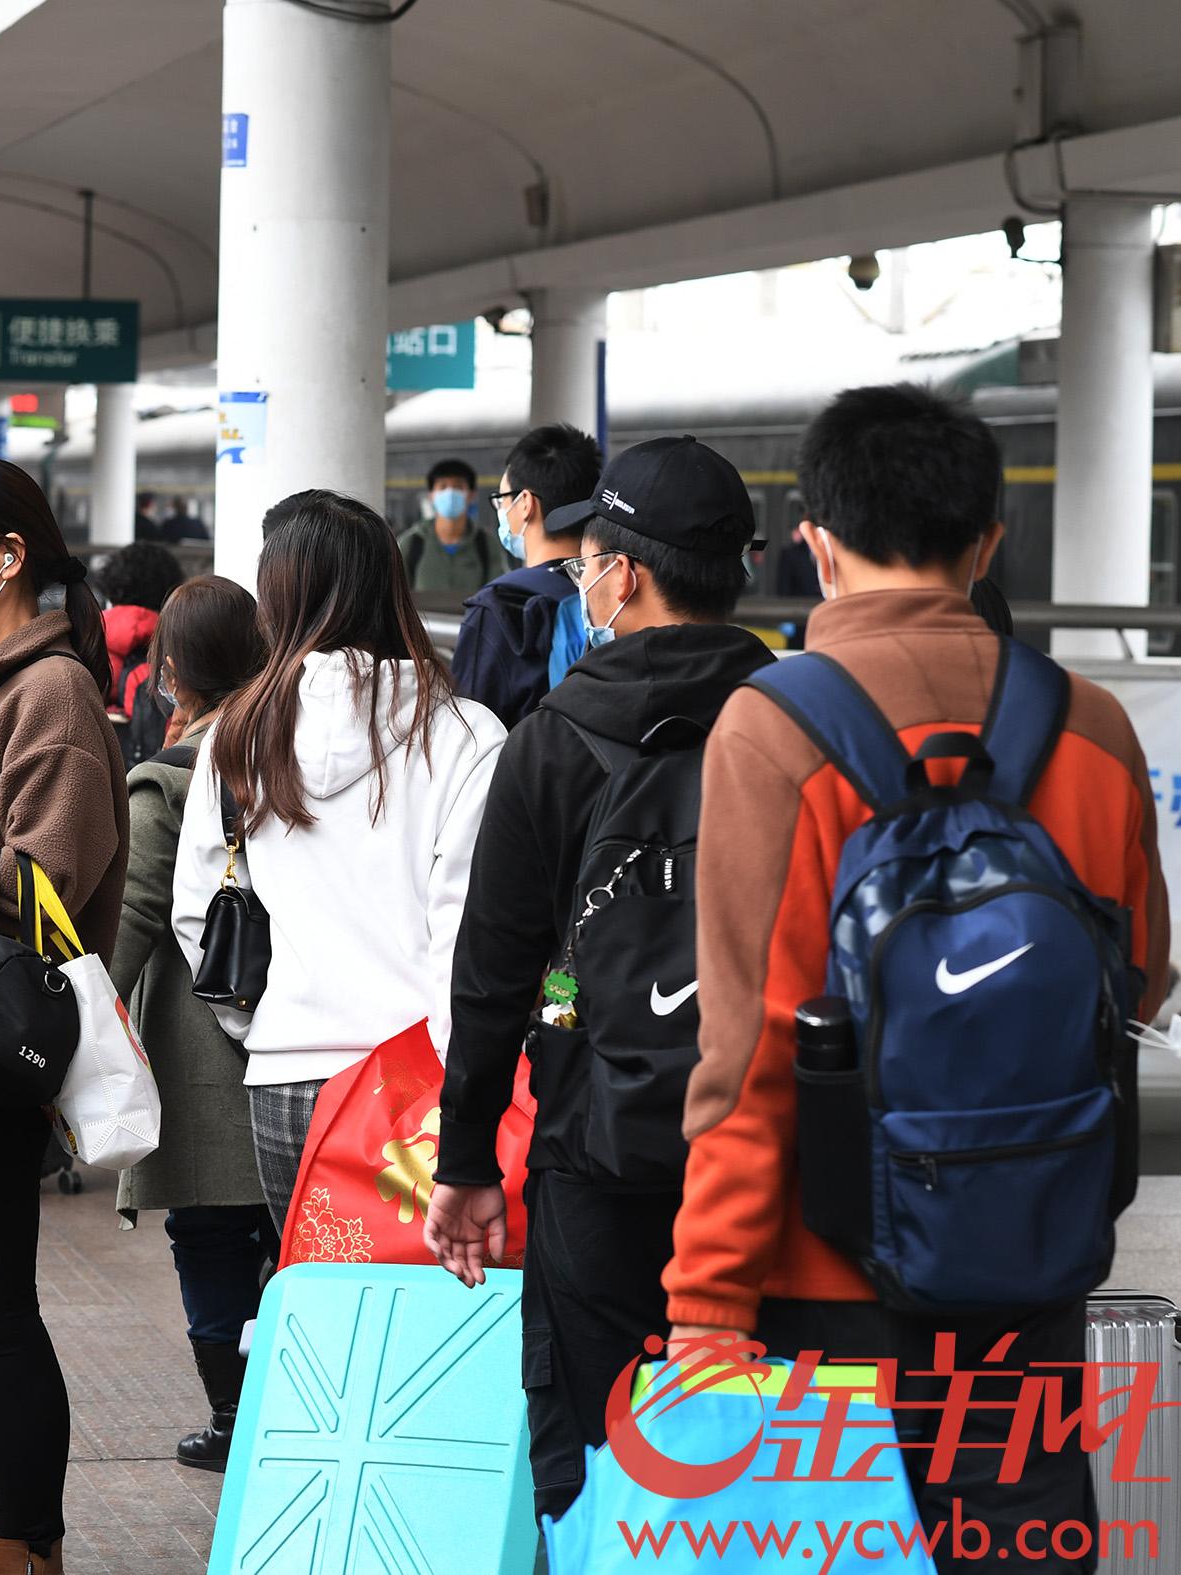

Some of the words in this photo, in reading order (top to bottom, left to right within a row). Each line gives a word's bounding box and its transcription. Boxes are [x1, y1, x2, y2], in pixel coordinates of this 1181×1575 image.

[7, 315, 119, 347] 便捷换乘
[387, 325, 457, 357] 站口
[18, 1045, 46, 1069] 1290
